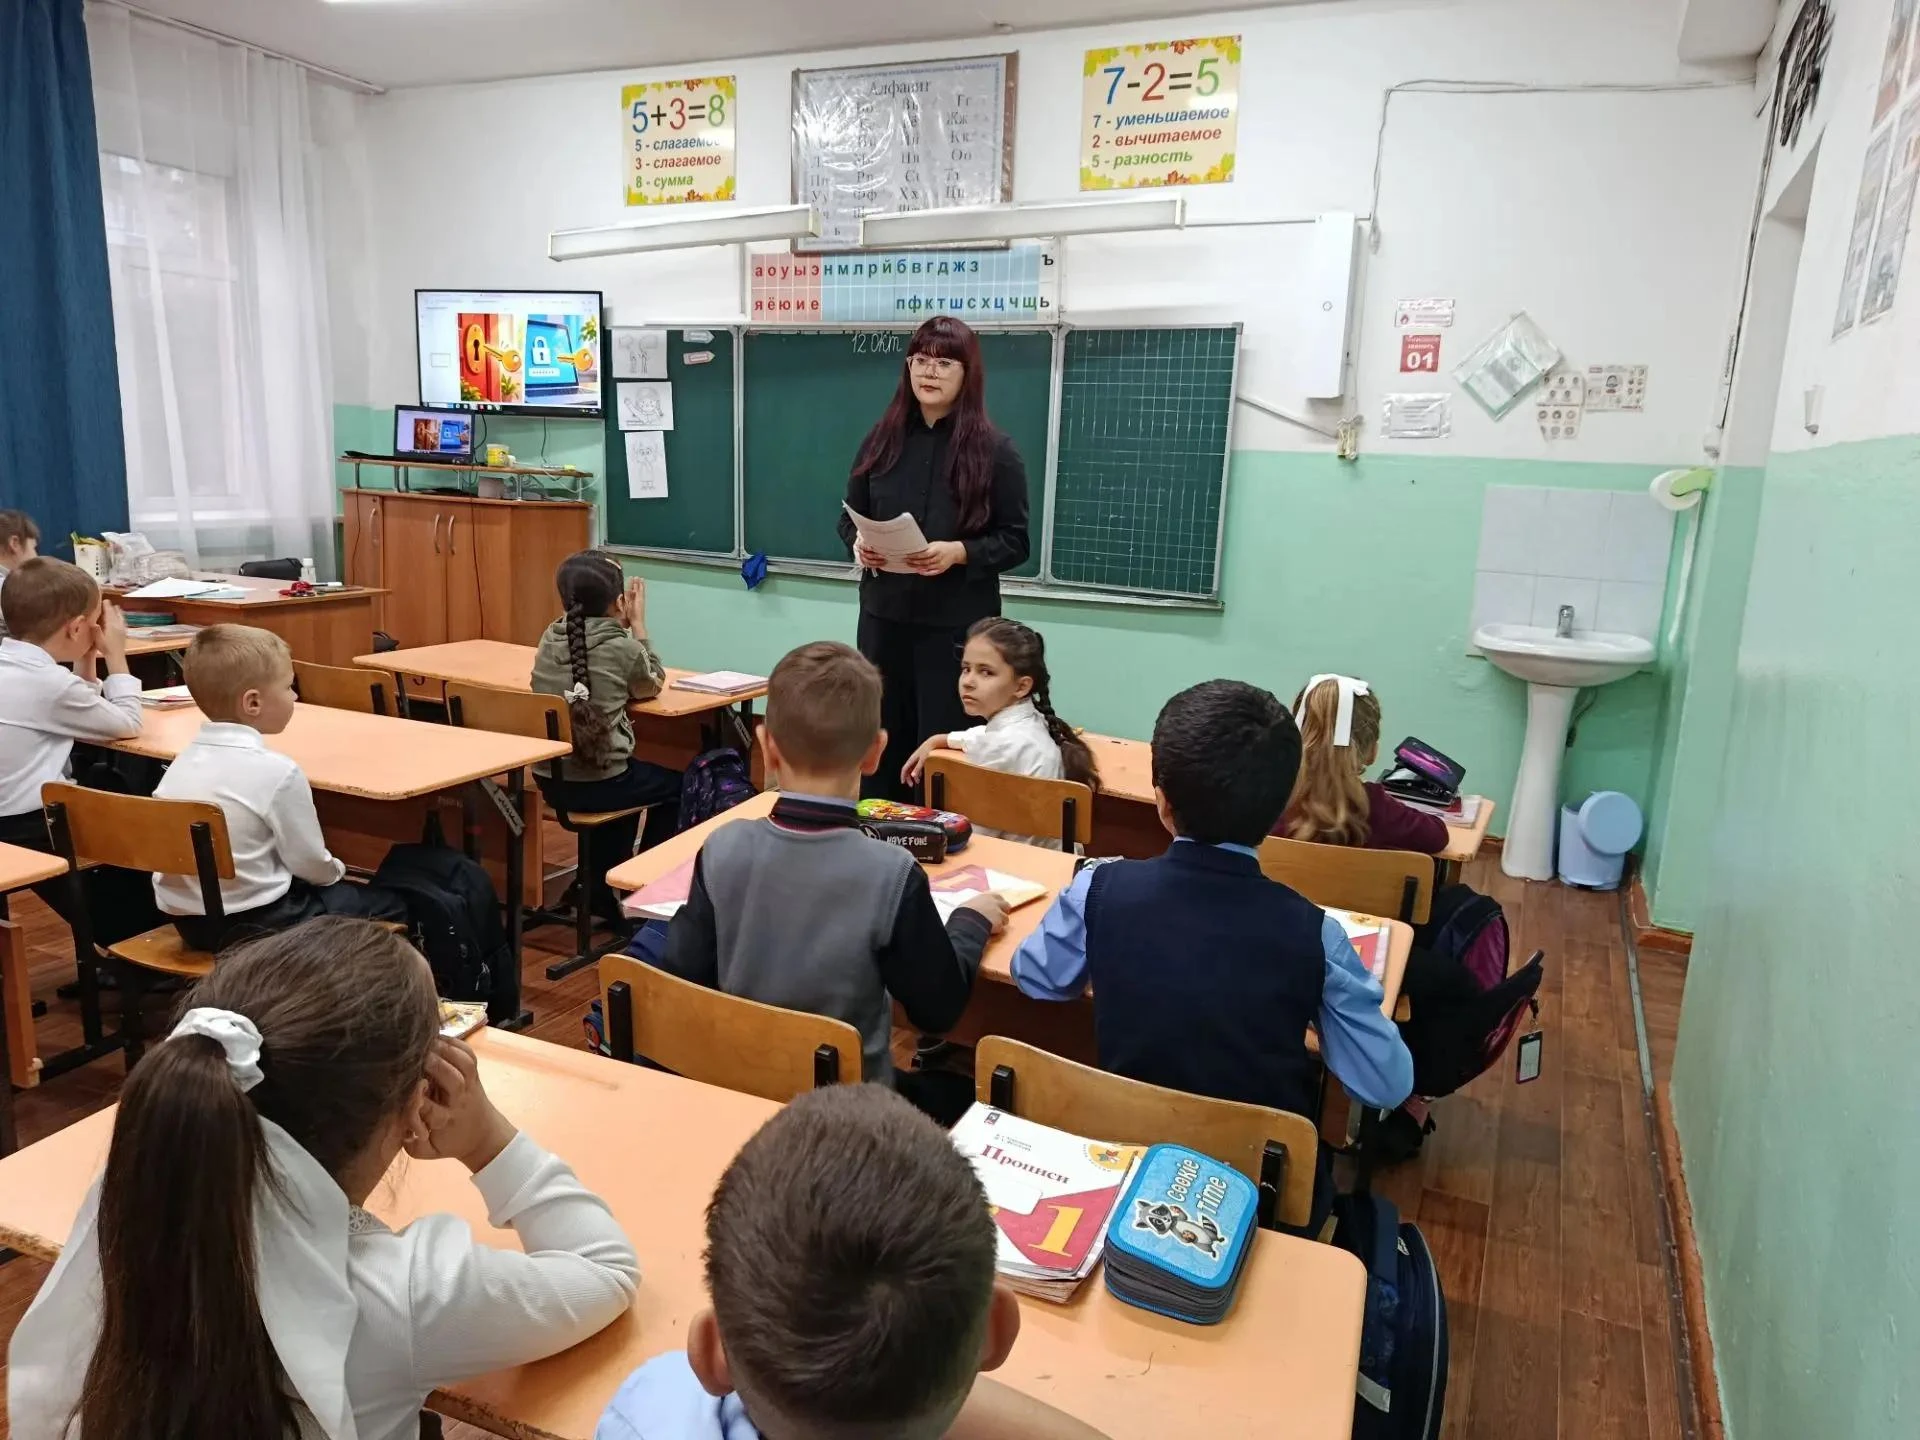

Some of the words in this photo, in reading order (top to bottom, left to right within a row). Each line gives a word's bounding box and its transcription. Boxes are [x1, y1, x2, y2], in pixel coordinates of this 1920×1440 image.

[1103, 58, 1219, 105] 7-2=5
[632, 95, 725, 133] 5+3=8
[1093, 115, 1101, 128] 7
[1115, 107, 1230, 130] уменьшаемое
[635, 139, 642, 152] 5
[1092, 135, 1100, 148] 2
[1115, 128, 1222, 147] вычитаемое
[635, 157, 642, 170] 3
[653, 155, 722, 169] слагаемое
[1092, 154, 1100, 168] 5
[1113, 151, 1192, 170] разность
[636, 175, 642, 188] 8
[653, 175, 694, 190] сумма
[852, 333, 866, 353] 12
[1406, 351, 1434, 370] 01
[980, 1143, 1071, 1185] Прописи
[1027, 1204, 1084, 1258] 1
